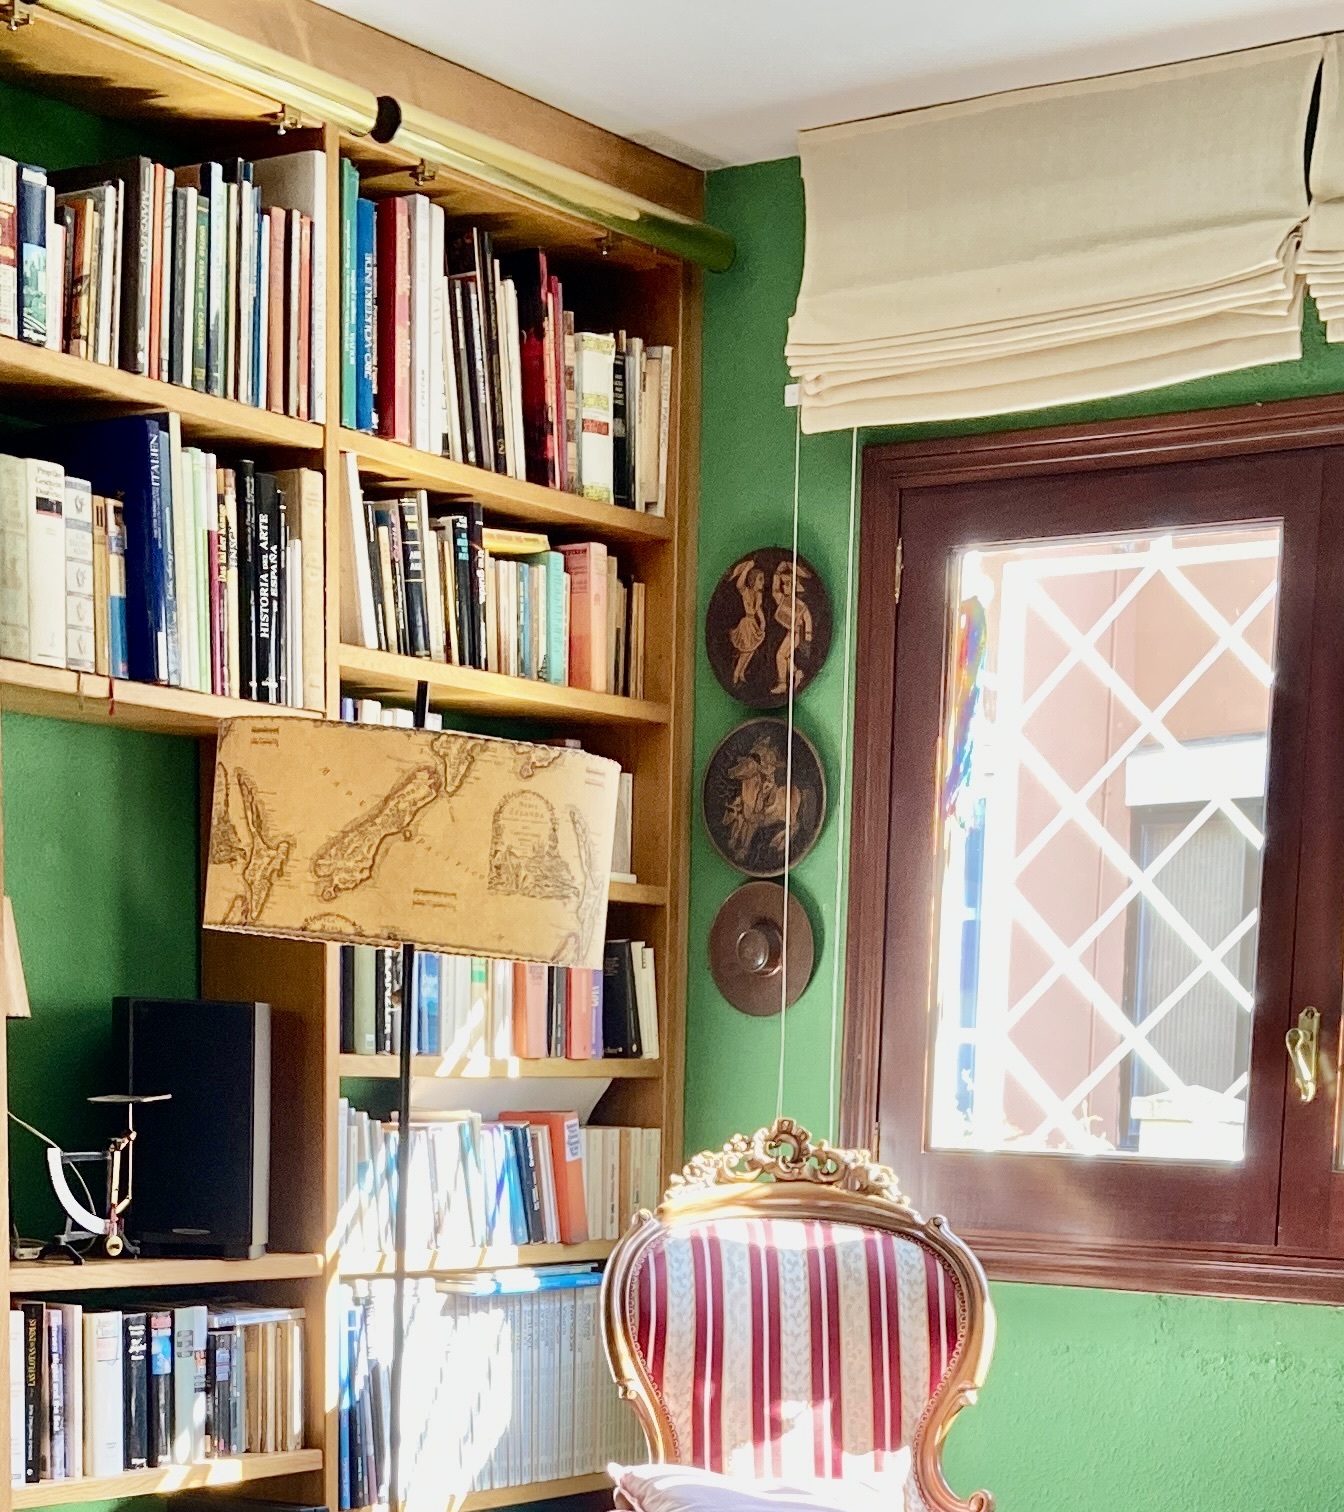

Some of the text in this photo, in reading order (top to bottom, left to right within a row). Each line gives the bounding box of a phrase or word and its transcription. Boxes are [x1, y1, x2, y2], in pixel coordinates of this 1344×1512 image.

[149, 433, 159, 487] ITALIEN
[259, 513, 269, 550] ARTE
[270, 545, 278, 597] ESPAÑA
[260, 573, 270, 638] HISTORIA
